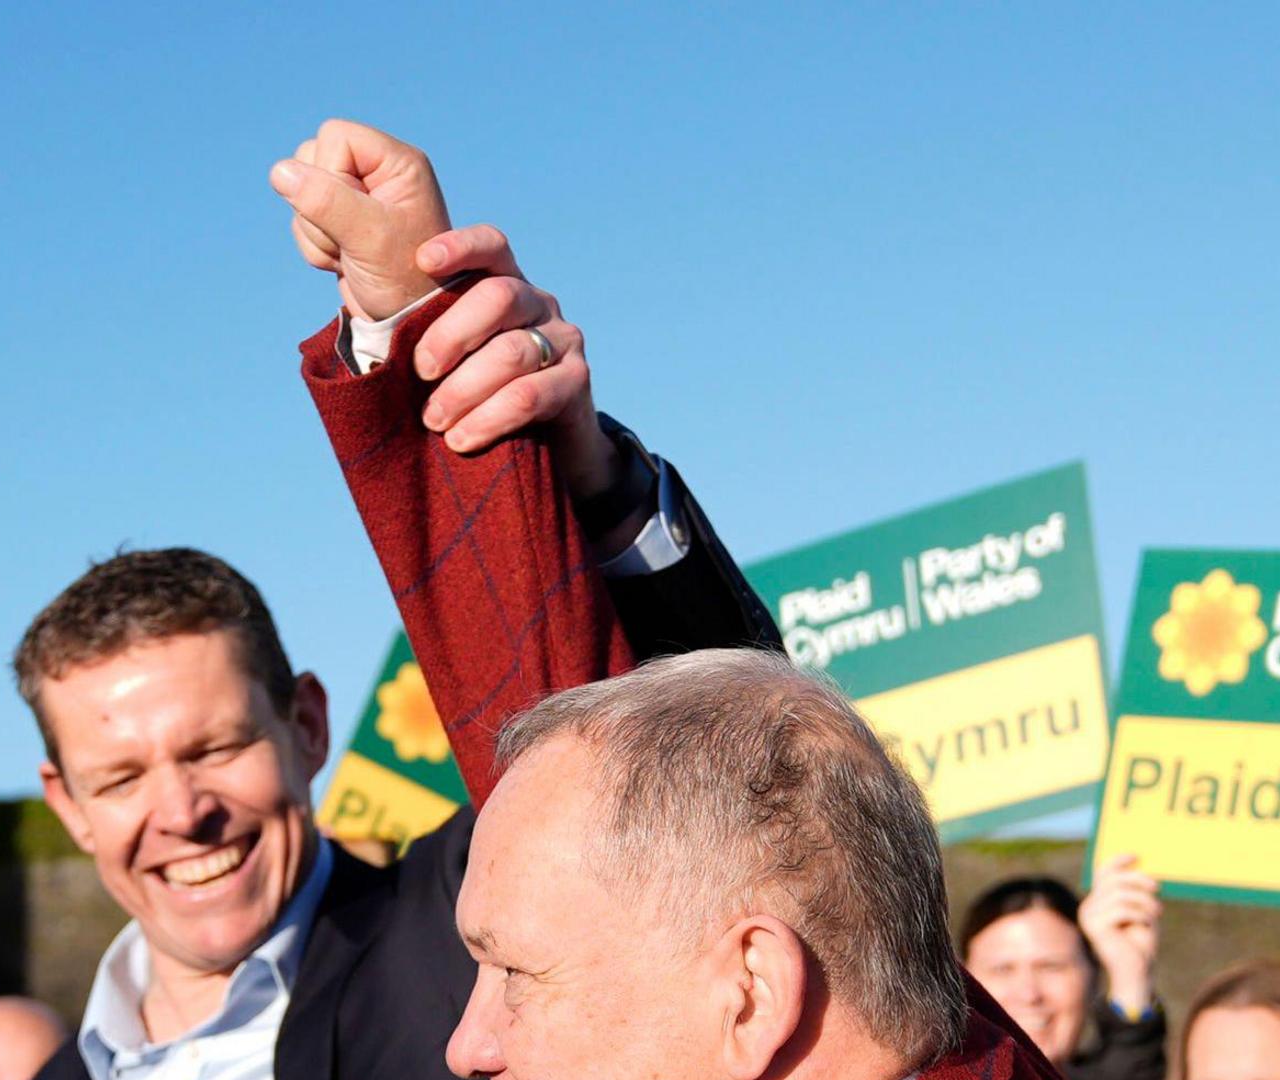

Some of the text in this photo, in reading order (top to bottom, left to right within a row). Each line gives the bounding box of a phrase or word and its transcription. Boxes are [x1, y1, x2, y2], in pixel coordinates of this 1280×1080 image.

[920, 511, 1066, 586] Party of
[778, 571, 872, 630] Plaid
[922, 566, 1042, 625] Wales
[783, 605, 907, 669] Cymru
[886, 698, 1081, 788] ymru
